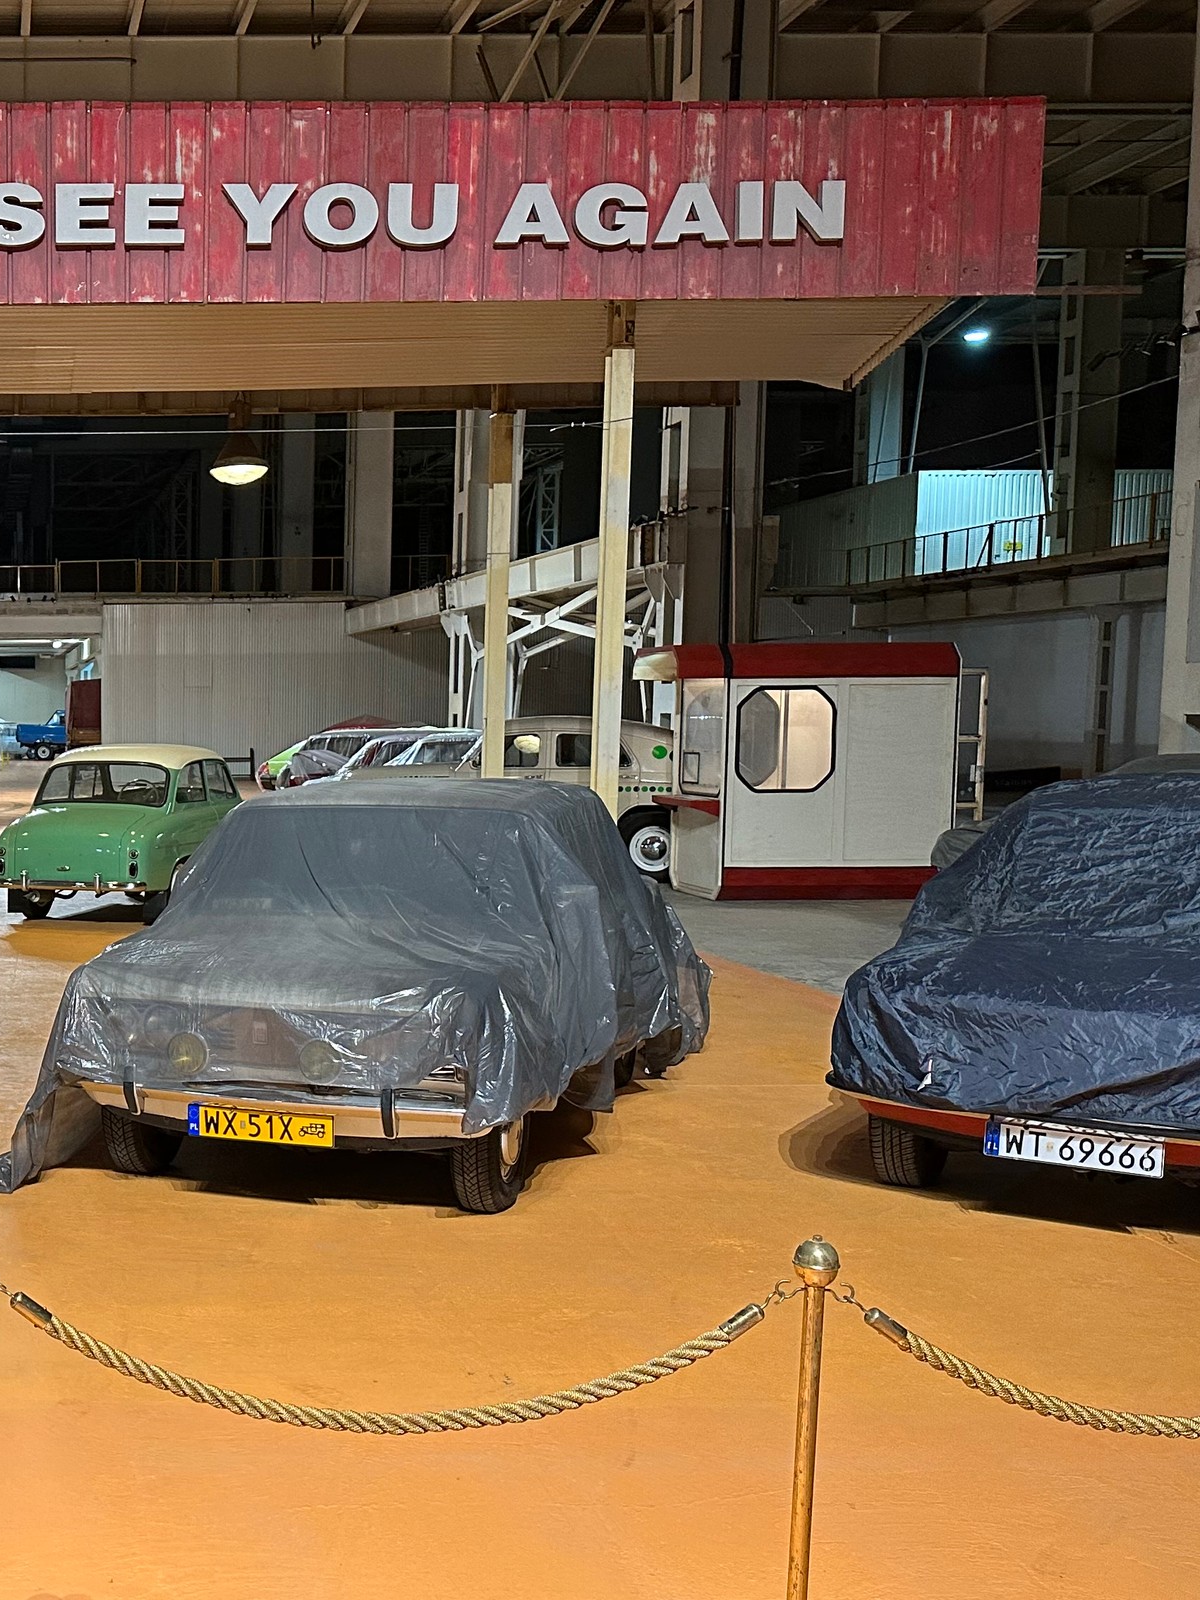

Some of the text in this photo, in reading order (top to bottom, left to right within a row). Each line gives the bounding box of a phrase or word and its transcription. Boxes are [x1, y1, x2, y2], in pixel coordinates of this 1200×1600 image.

[221, 182, 461, 249] YOU
[493, 180, 847, 249] AGAIN
[189, 1122, 199, 1131] PL
[204, 1109, 294, 1141] WX 51X
[1005, 1127, 1157, 1172] WT 69666
